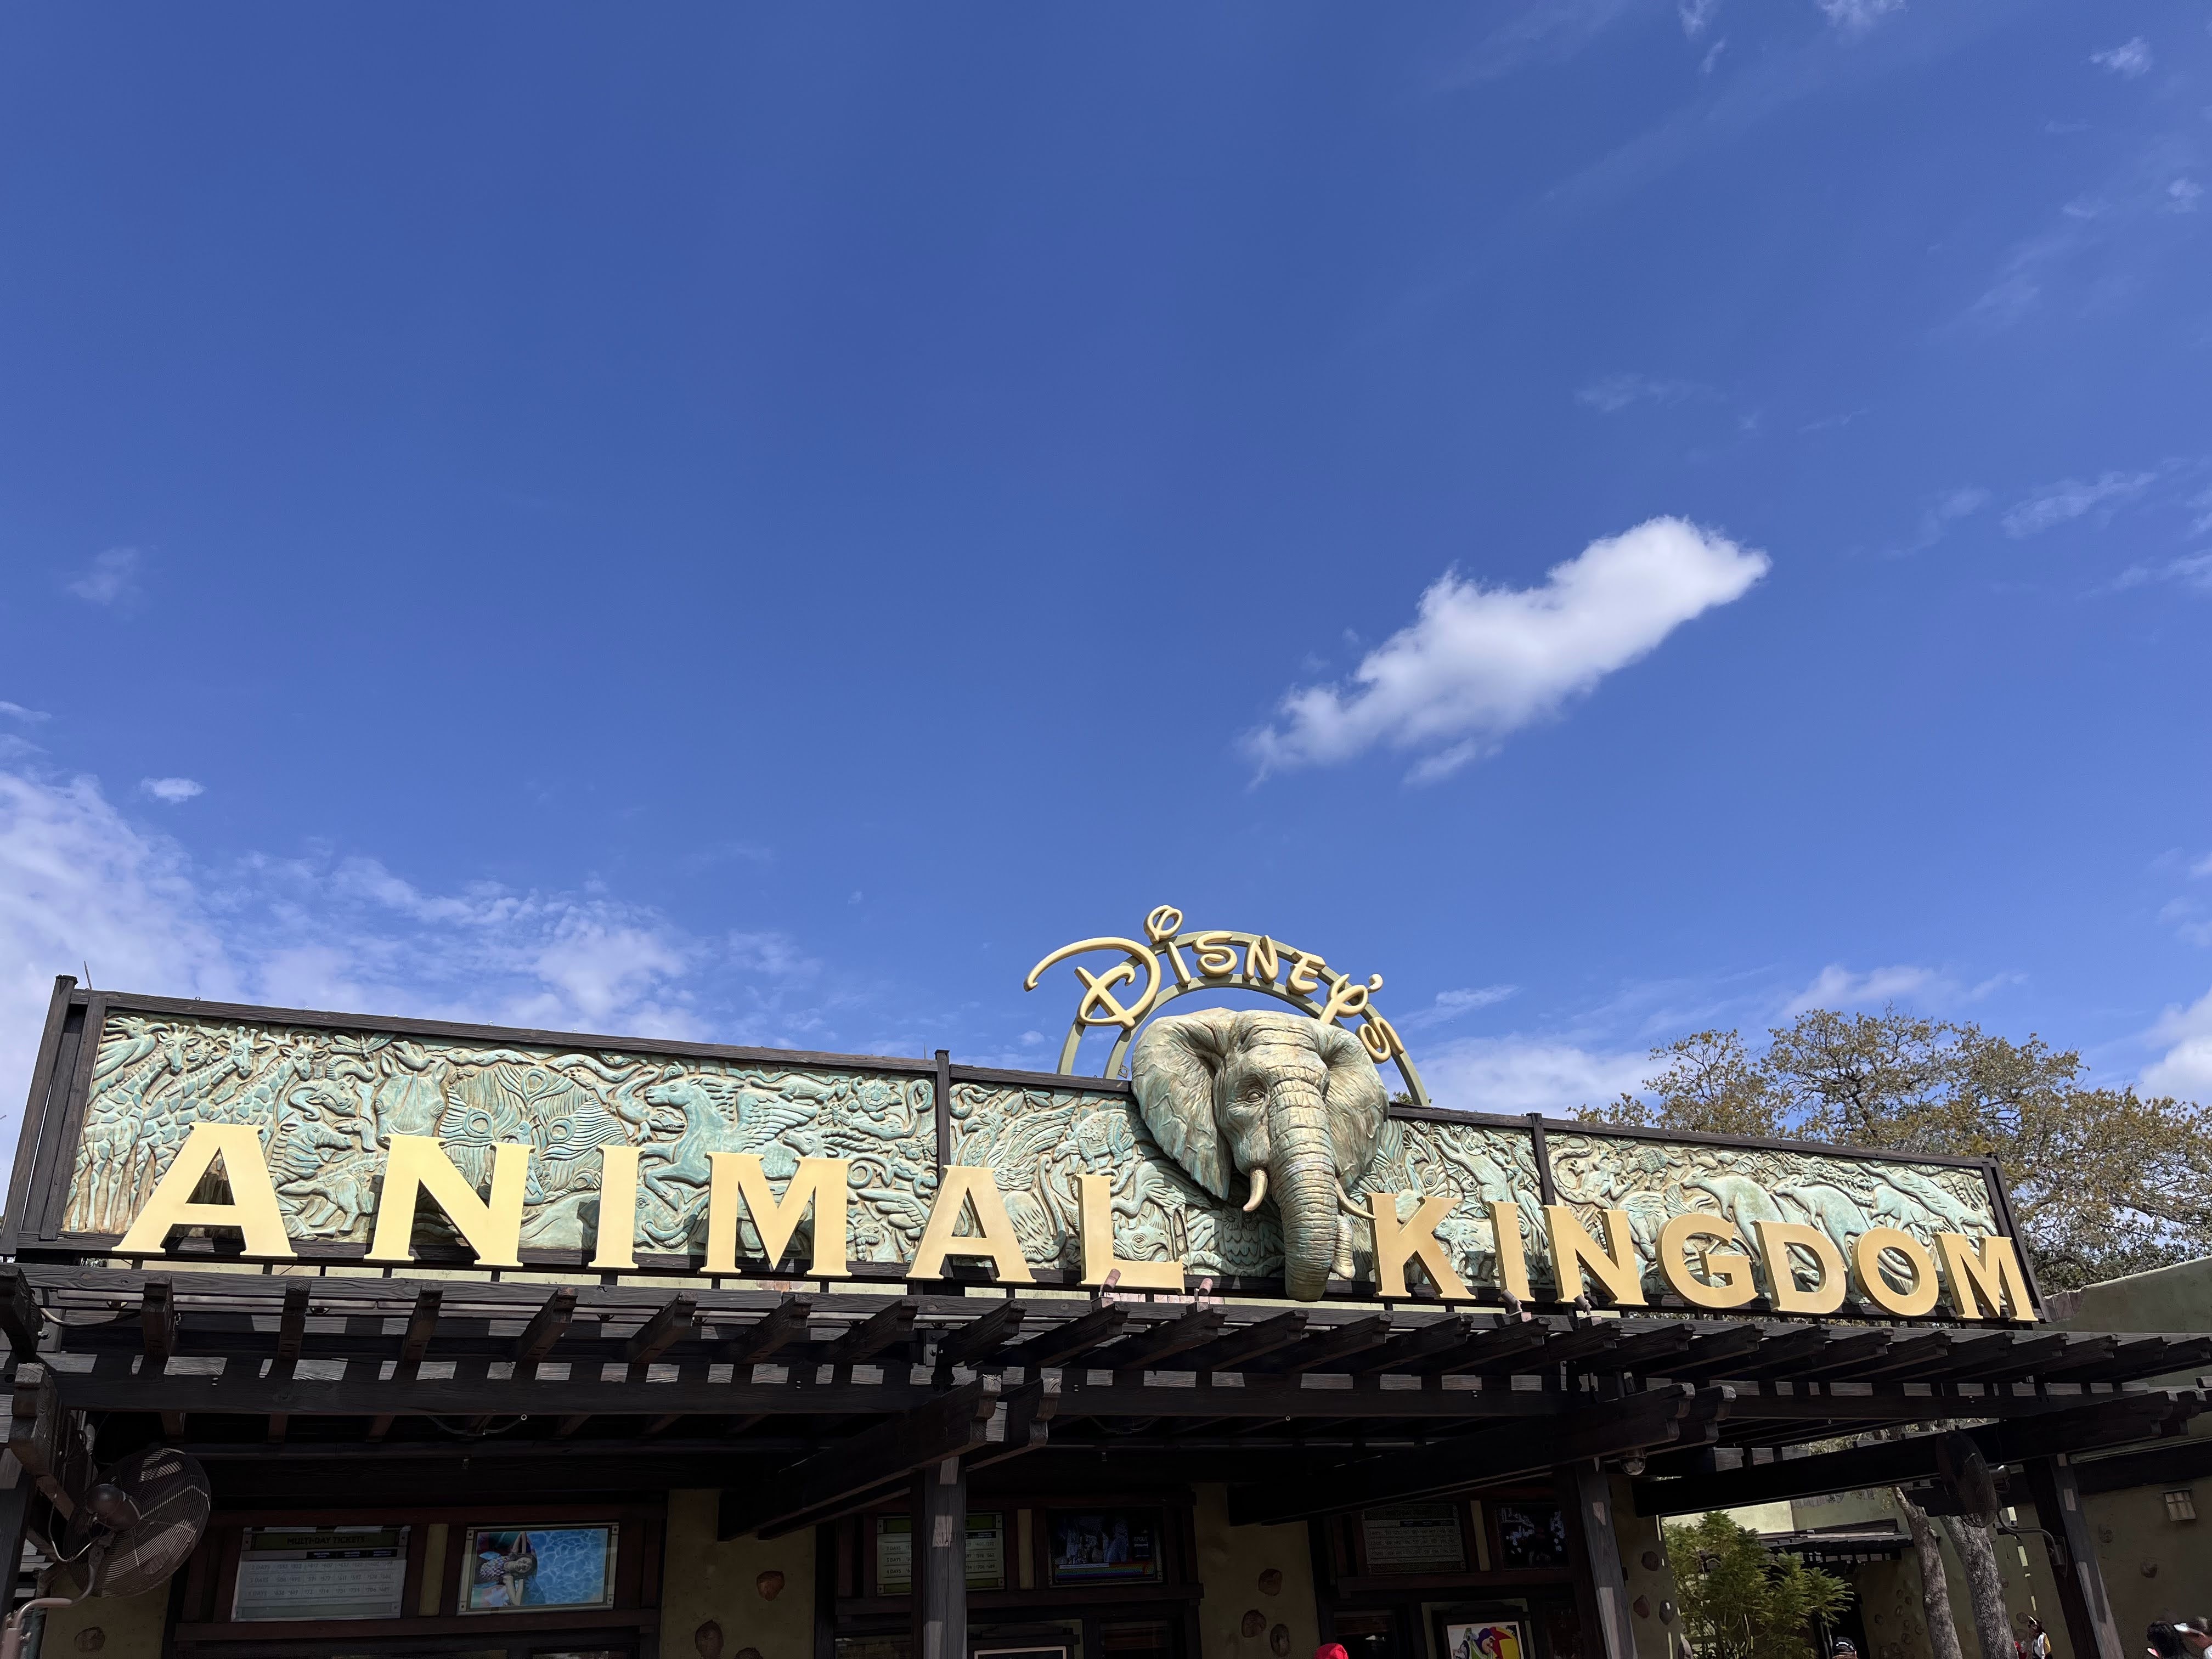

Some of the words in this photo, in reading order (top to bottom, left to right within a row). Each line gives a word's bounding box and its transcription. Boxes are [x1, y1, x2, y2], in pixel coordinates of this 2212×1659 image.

[111, 1121, 1185, 1294] ANIMAL
[1365, 1192, 2040, 1323] KINGDOM
[287, 1536, 330, 1545] MULTI-DAY
[334, 1536, 365, 1544] TICKETS
